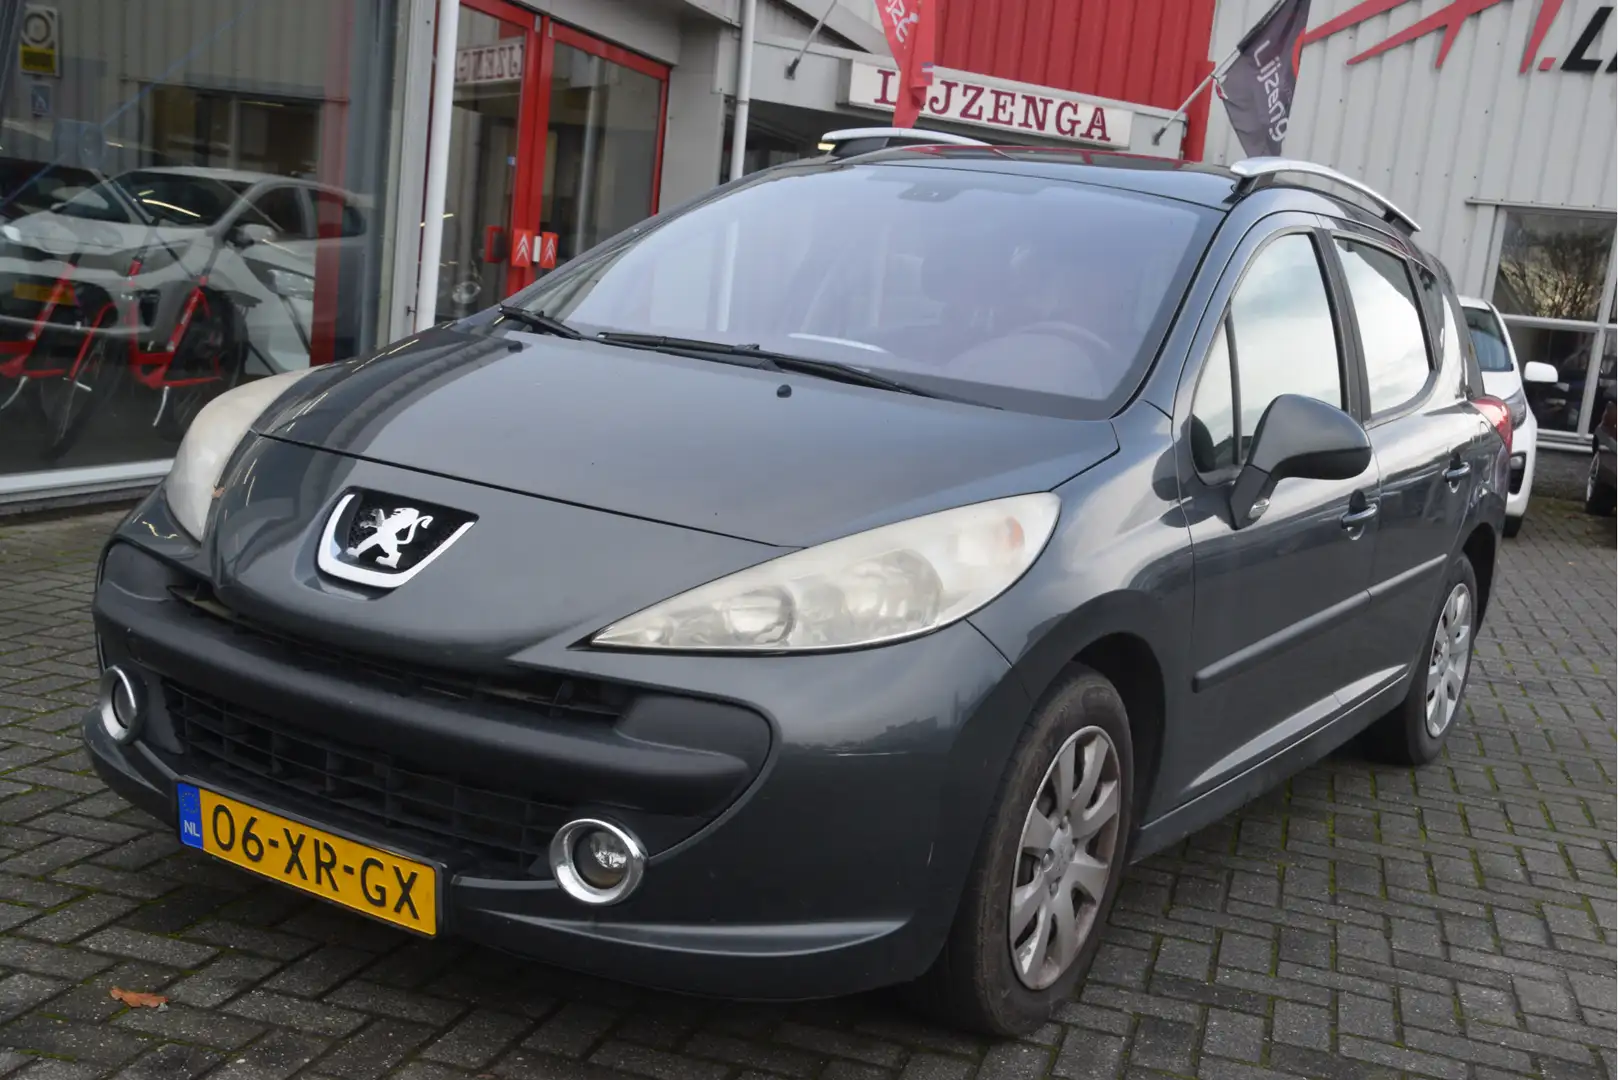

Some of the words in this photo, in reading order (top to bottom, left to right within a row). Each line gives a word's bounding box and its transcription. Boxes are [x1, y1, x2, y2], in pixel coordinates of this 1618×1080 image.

[873, 69, 1111, 142] LJZENGA
[184, 821, 200, 837] NL
[212, 804, 421, 920] 06-XR-GX
